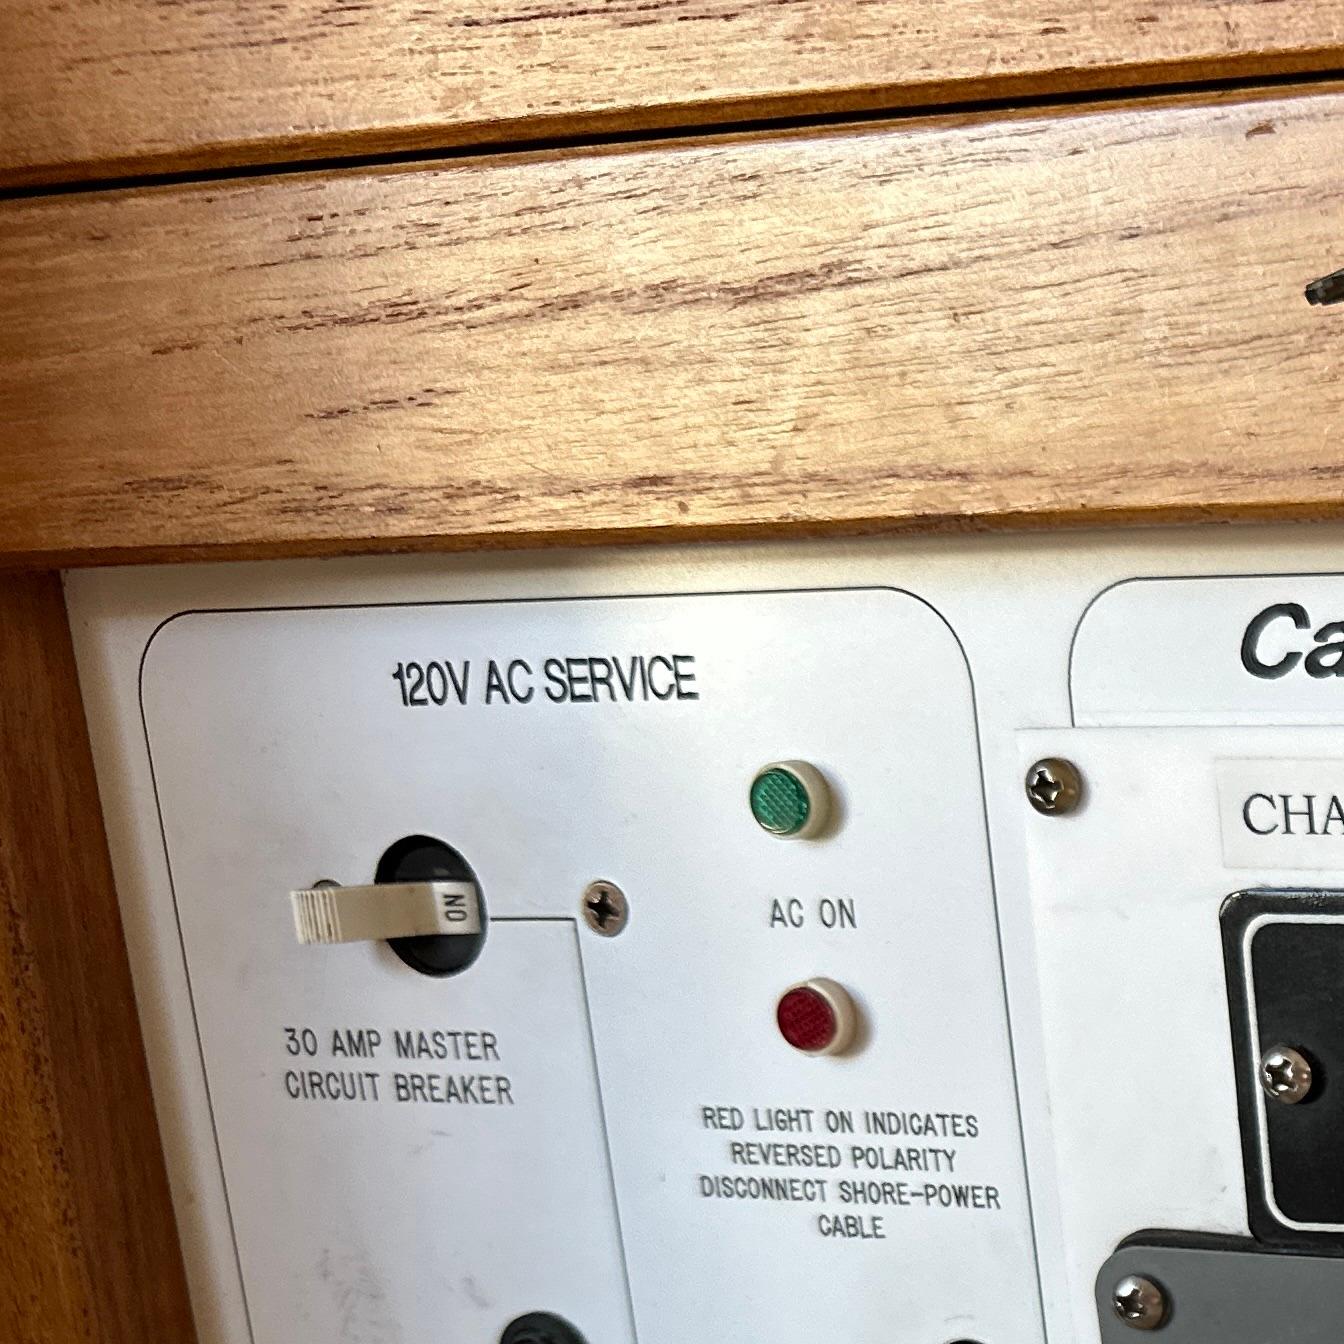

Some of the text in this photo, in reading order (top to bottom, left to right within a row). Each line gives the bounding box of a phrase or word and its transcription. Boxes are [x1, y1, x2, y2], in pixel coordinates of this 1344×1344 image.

[393, 653, 700, 706] 120V AC SERVICE
[443, 893, 468, 922] ON
[769, 897, 858, 931] AC ON
[284, 1028, 500, 1063] 30 AMP MASTER
[284, 1070, 514, 1107] CIRCUIT BREAKER
[701, 1105, 980, 1139] RED LIGHT ON INDICATES
[731, 1142, 957, 1174] REVERSED POLARITY
[700, 1175, 1001, 1211] DISCONNECT SHORE-POWER
[817, 1214, 885, 1241] CABLE
